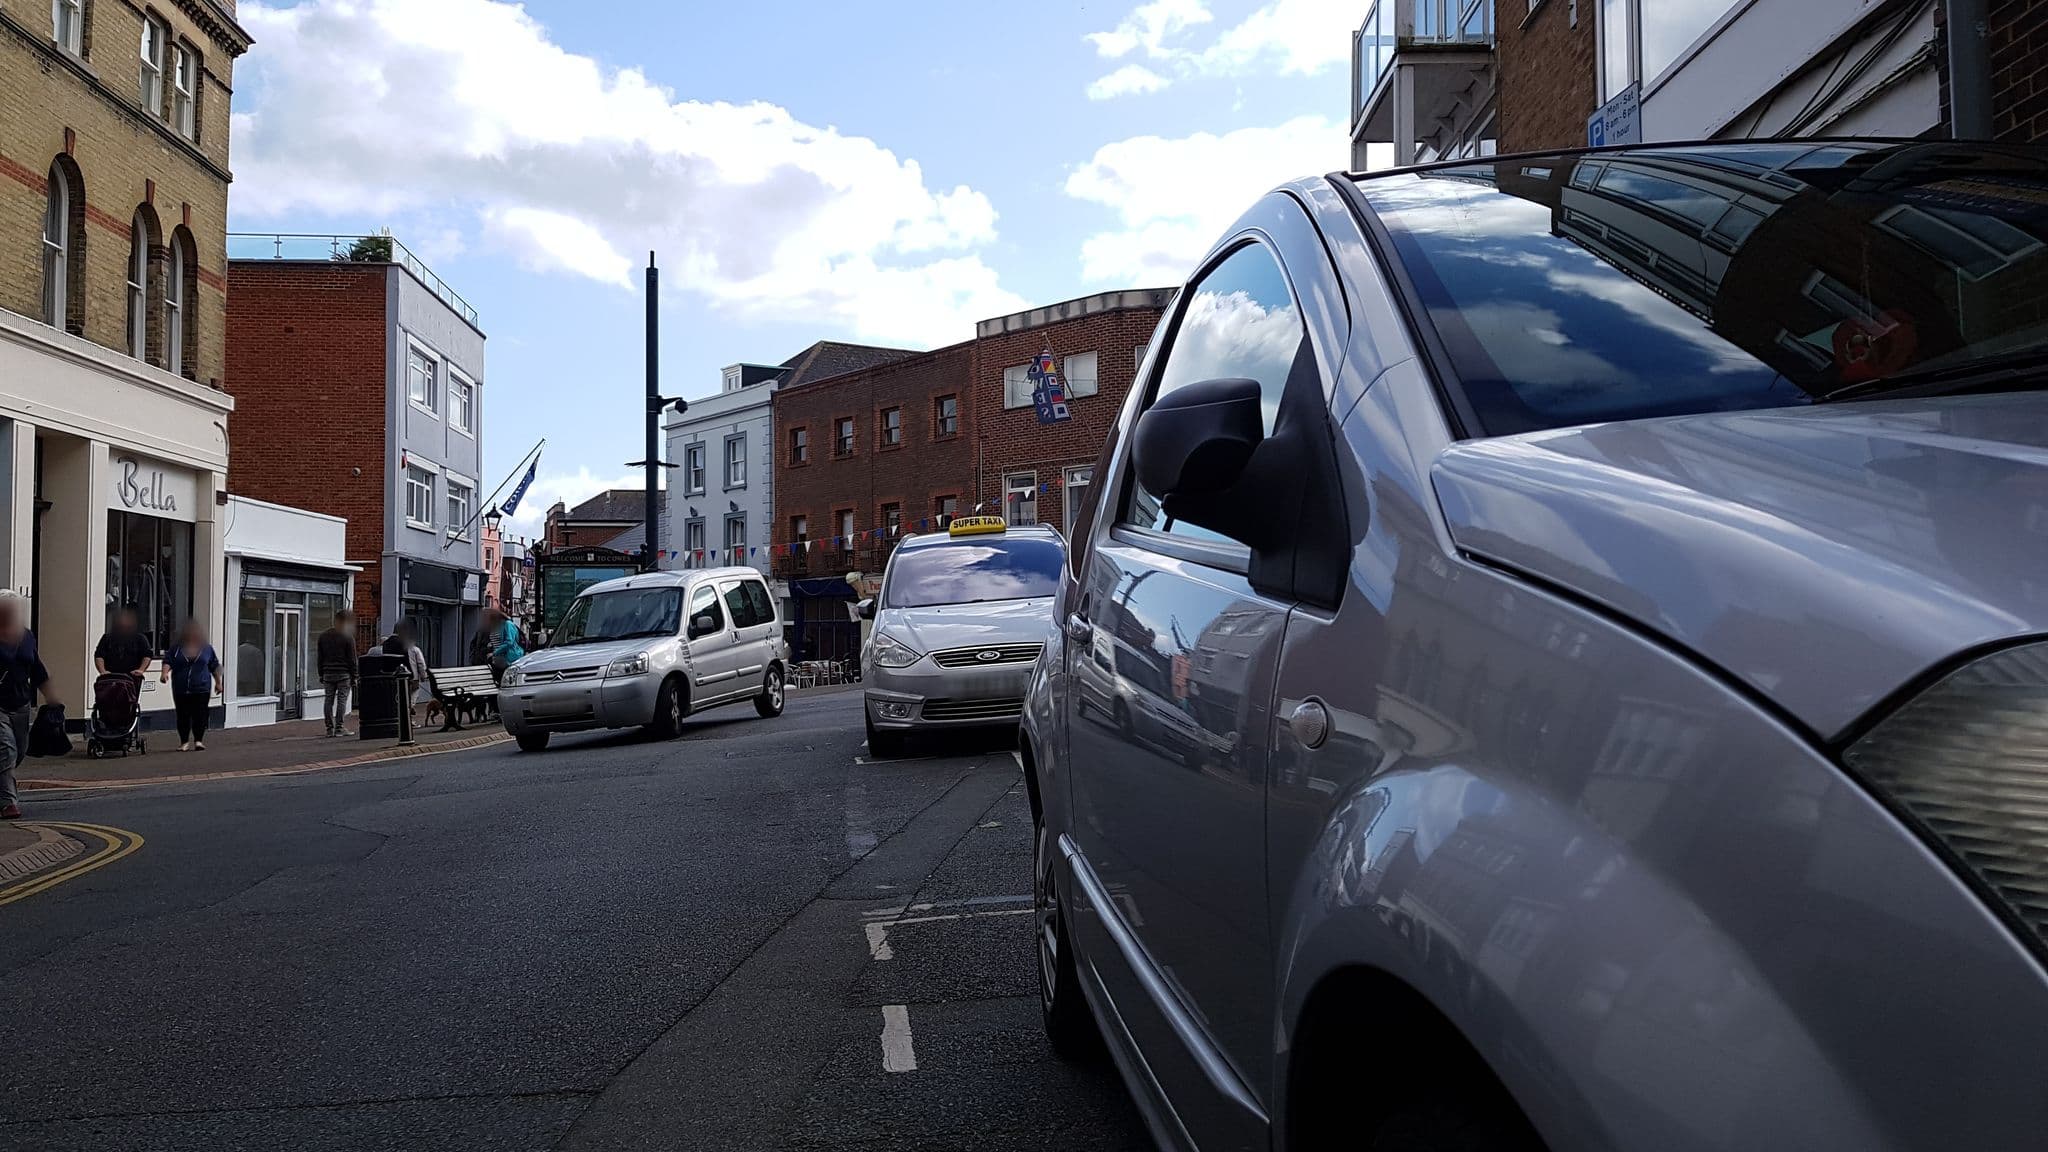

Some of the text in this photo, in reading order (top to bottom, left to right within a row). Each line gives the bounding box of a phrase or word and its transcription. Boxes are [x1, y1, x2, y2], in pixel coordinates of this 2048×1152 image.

[1607, 103, 1619, 116] Mon
[1624, 91, 1634, 104] Sat
[1617, 124, 1631, 138] hour
[117, 458, 176, 511] Bella
[953, 517, 1002, 528] SUPER TAXI
